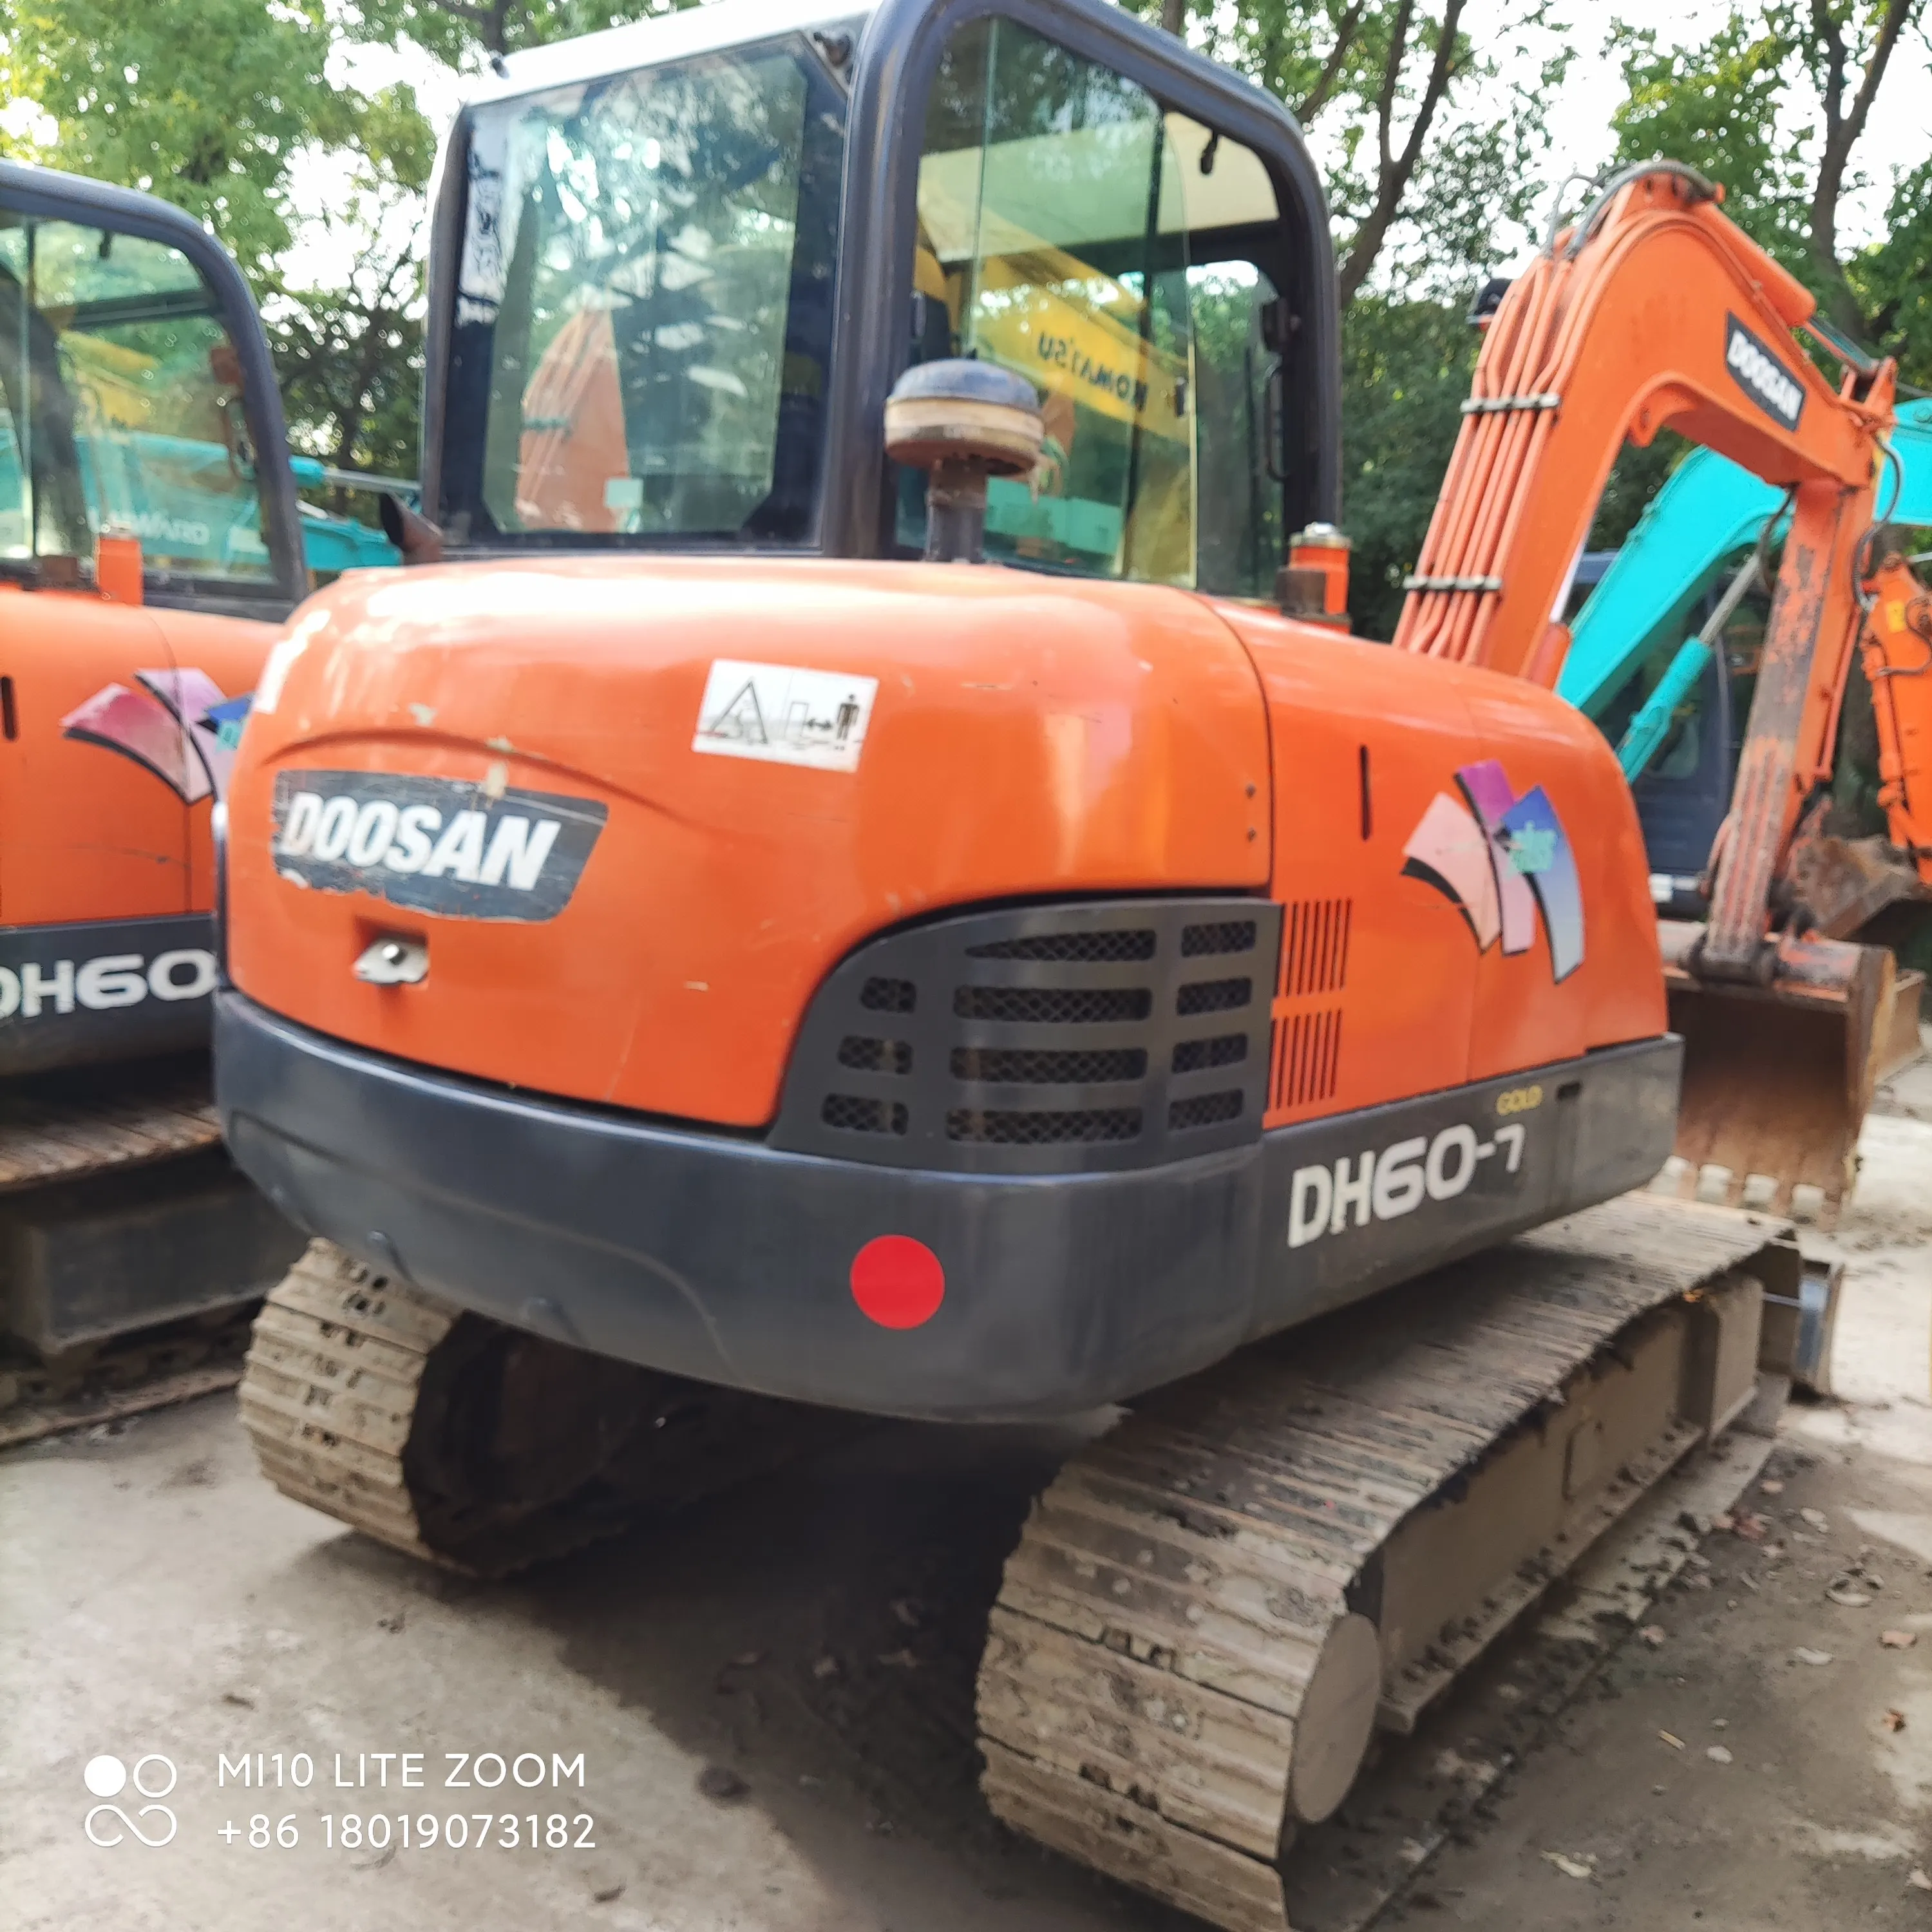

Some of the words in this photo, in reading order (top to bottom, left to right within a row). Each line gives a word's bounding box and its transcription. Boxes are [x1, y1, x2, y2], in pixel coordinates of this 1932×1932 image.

[1727, 329, 1803, 421] DOOSAN
[278, 791, 562, 891] DOOSAN
[1497, 1085, 1543, 1116] GOLD
[1287, 1123, 1526, 1249] DH60-7
